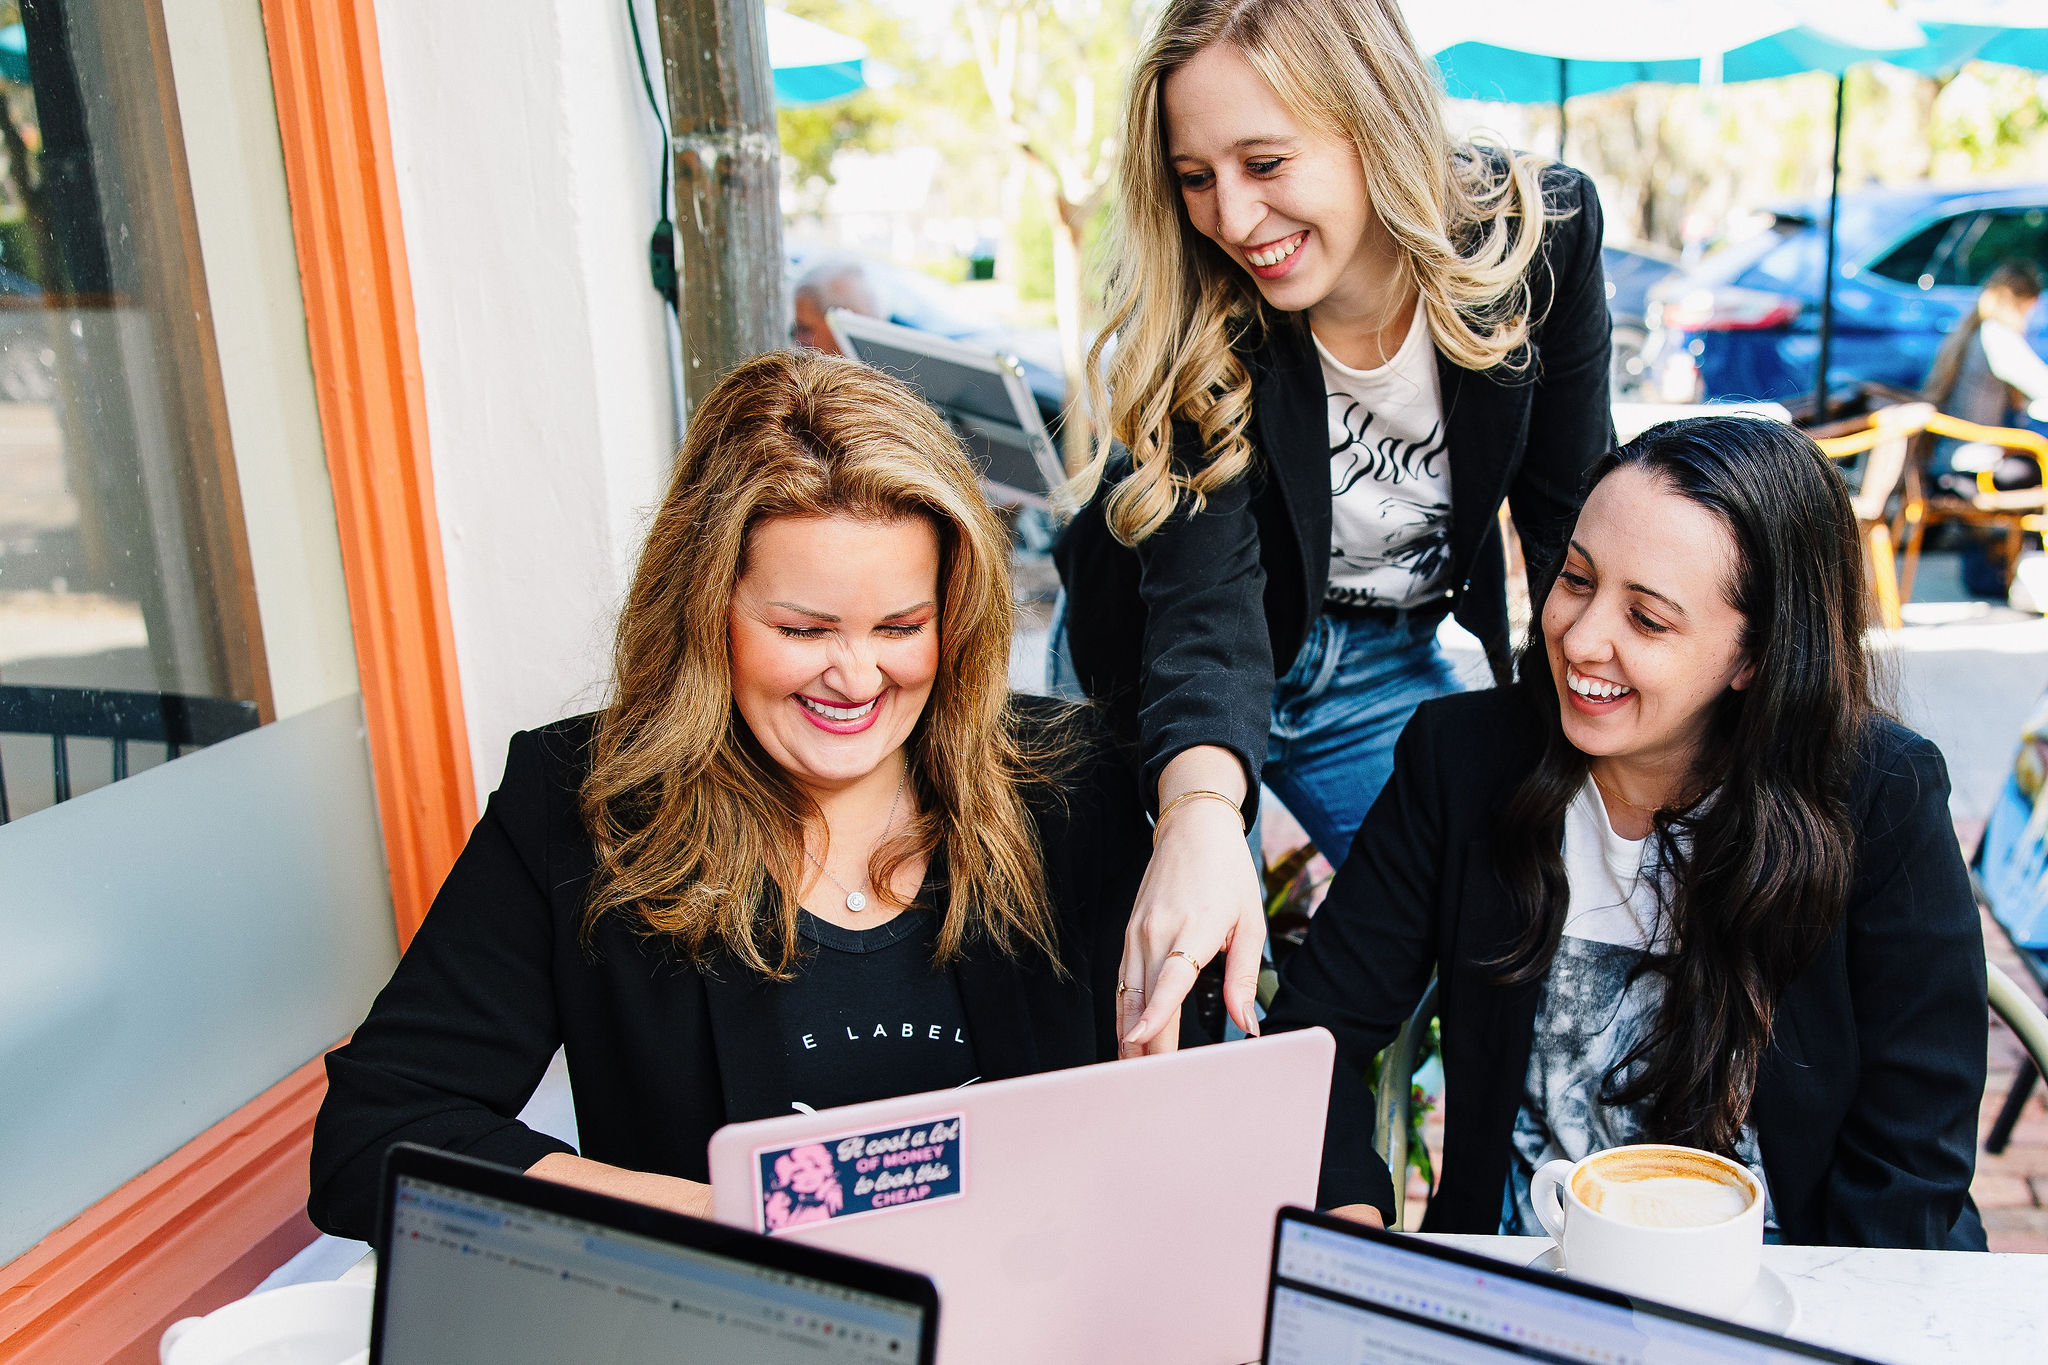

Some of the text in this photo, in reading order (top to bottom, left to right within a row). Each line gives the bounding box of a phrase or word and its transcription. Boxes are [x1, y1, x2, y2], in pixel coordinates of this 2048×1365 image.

[846, 1023, 965, 1044] LABEL
[865, 1128, 911, 1156] cost
[910, 1130, 927, 1148] a
[928, 1119, 959, 1144] lot
[856, 1143, 944, 1173] OF MONEY
[853, 1162, 952, 1196] to look this
[871, 1184, 932, 1208] CHEAP
